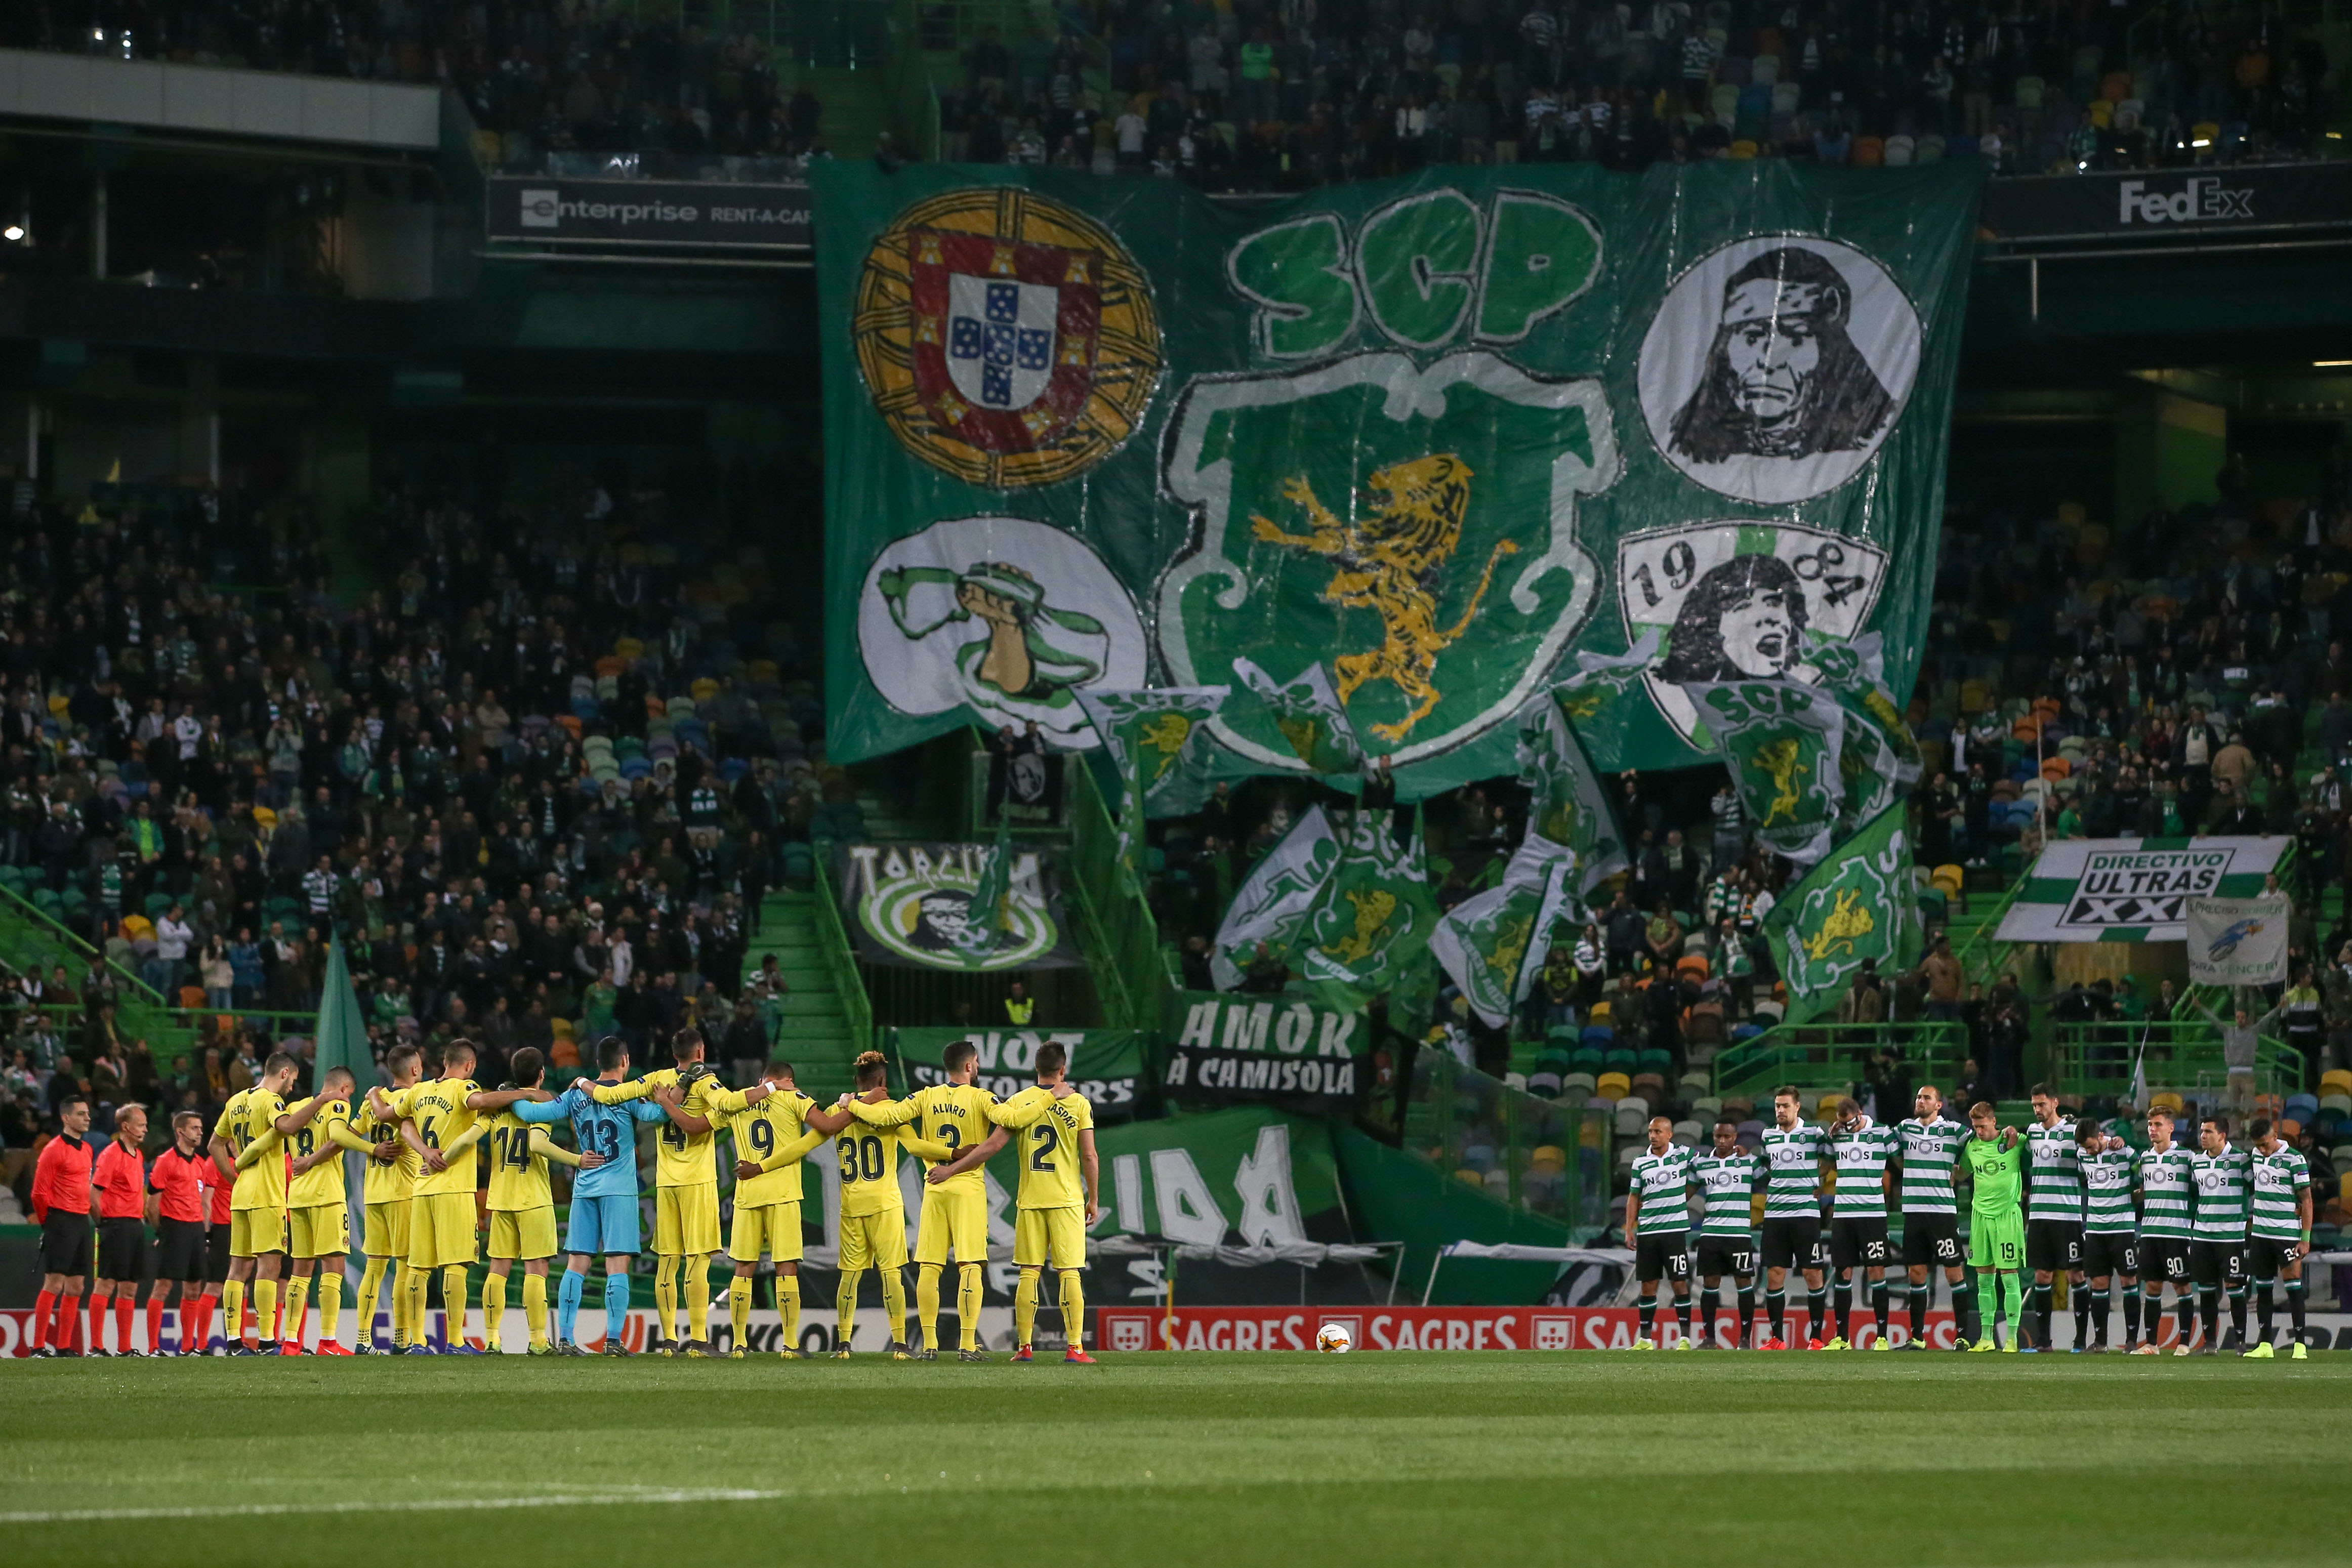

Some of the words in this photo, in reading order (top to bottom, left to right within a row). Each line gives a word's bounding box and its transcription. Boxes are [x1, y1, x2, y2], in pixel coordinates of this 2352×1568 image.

[524, 192, 697, 225] enterprise
[2120, 177, 2255, 224] FedEx
[1227, 187, 1606, 360] SCP
[1706, 683, 1813, 723] SCP
[2092, 853, 2224, 870] DIRECTIVO
[2084, 869, 2216, 894] ULTRAS
[1179, 1000, 1357, 1059] AMOR
[1198, 1057, 1355, 1095] CAMISOLA
[933, 1103, 966, 1118] ÁLVARO
[1047, 1103, 1077, 1130] ASPAR
[582, 1119, 620, 1164] 13
[749, 1118, 774, 1162] 9
[1030, 1124, 1058, 1173] 2
[1908, 1139, 1941, 1155] NOS
[494, 1127, 531, 1174] 14
[837, 1135, 884, 1184] 30
[1771, 1147, 1802, 1163] NOS
[1839, 1146, 1870, 1163] NOS
[2033, 1144, 2059, 1161] NOS
[1976, 1159, 2006, 1176] NOS
[2086, 1168, 2116, 1184] NOS
[2145, 1167, 2174, 1184] NOS
[1646, 1169, 1677, 1186] NOS
[1707, 1171, 1739, 1187] NOS
[2198, 1172, 2226, 1190] NOS
[1811, 1243, 1820, 1260] 4
[1867, 1241, 1885, 1259] 25
[1936, 1238, 1955, 1257] 28
[2000, 1242, 2014, 1259] 19
[2069, 1242, 2078, 1259] 6
[1669, 1254, 1687, 1273] 76
[1732, 1252, 1750, 1269] 77
[2125, 1248, 2135, 1266] 8
[2167, 1256, 2183, 1275] 90
[2230, 1256, 2239, 1274] 9
[1158, 1315, 1306, 1350] SAGRES
[1371, 1315, 1518, 1350] SAGRES
